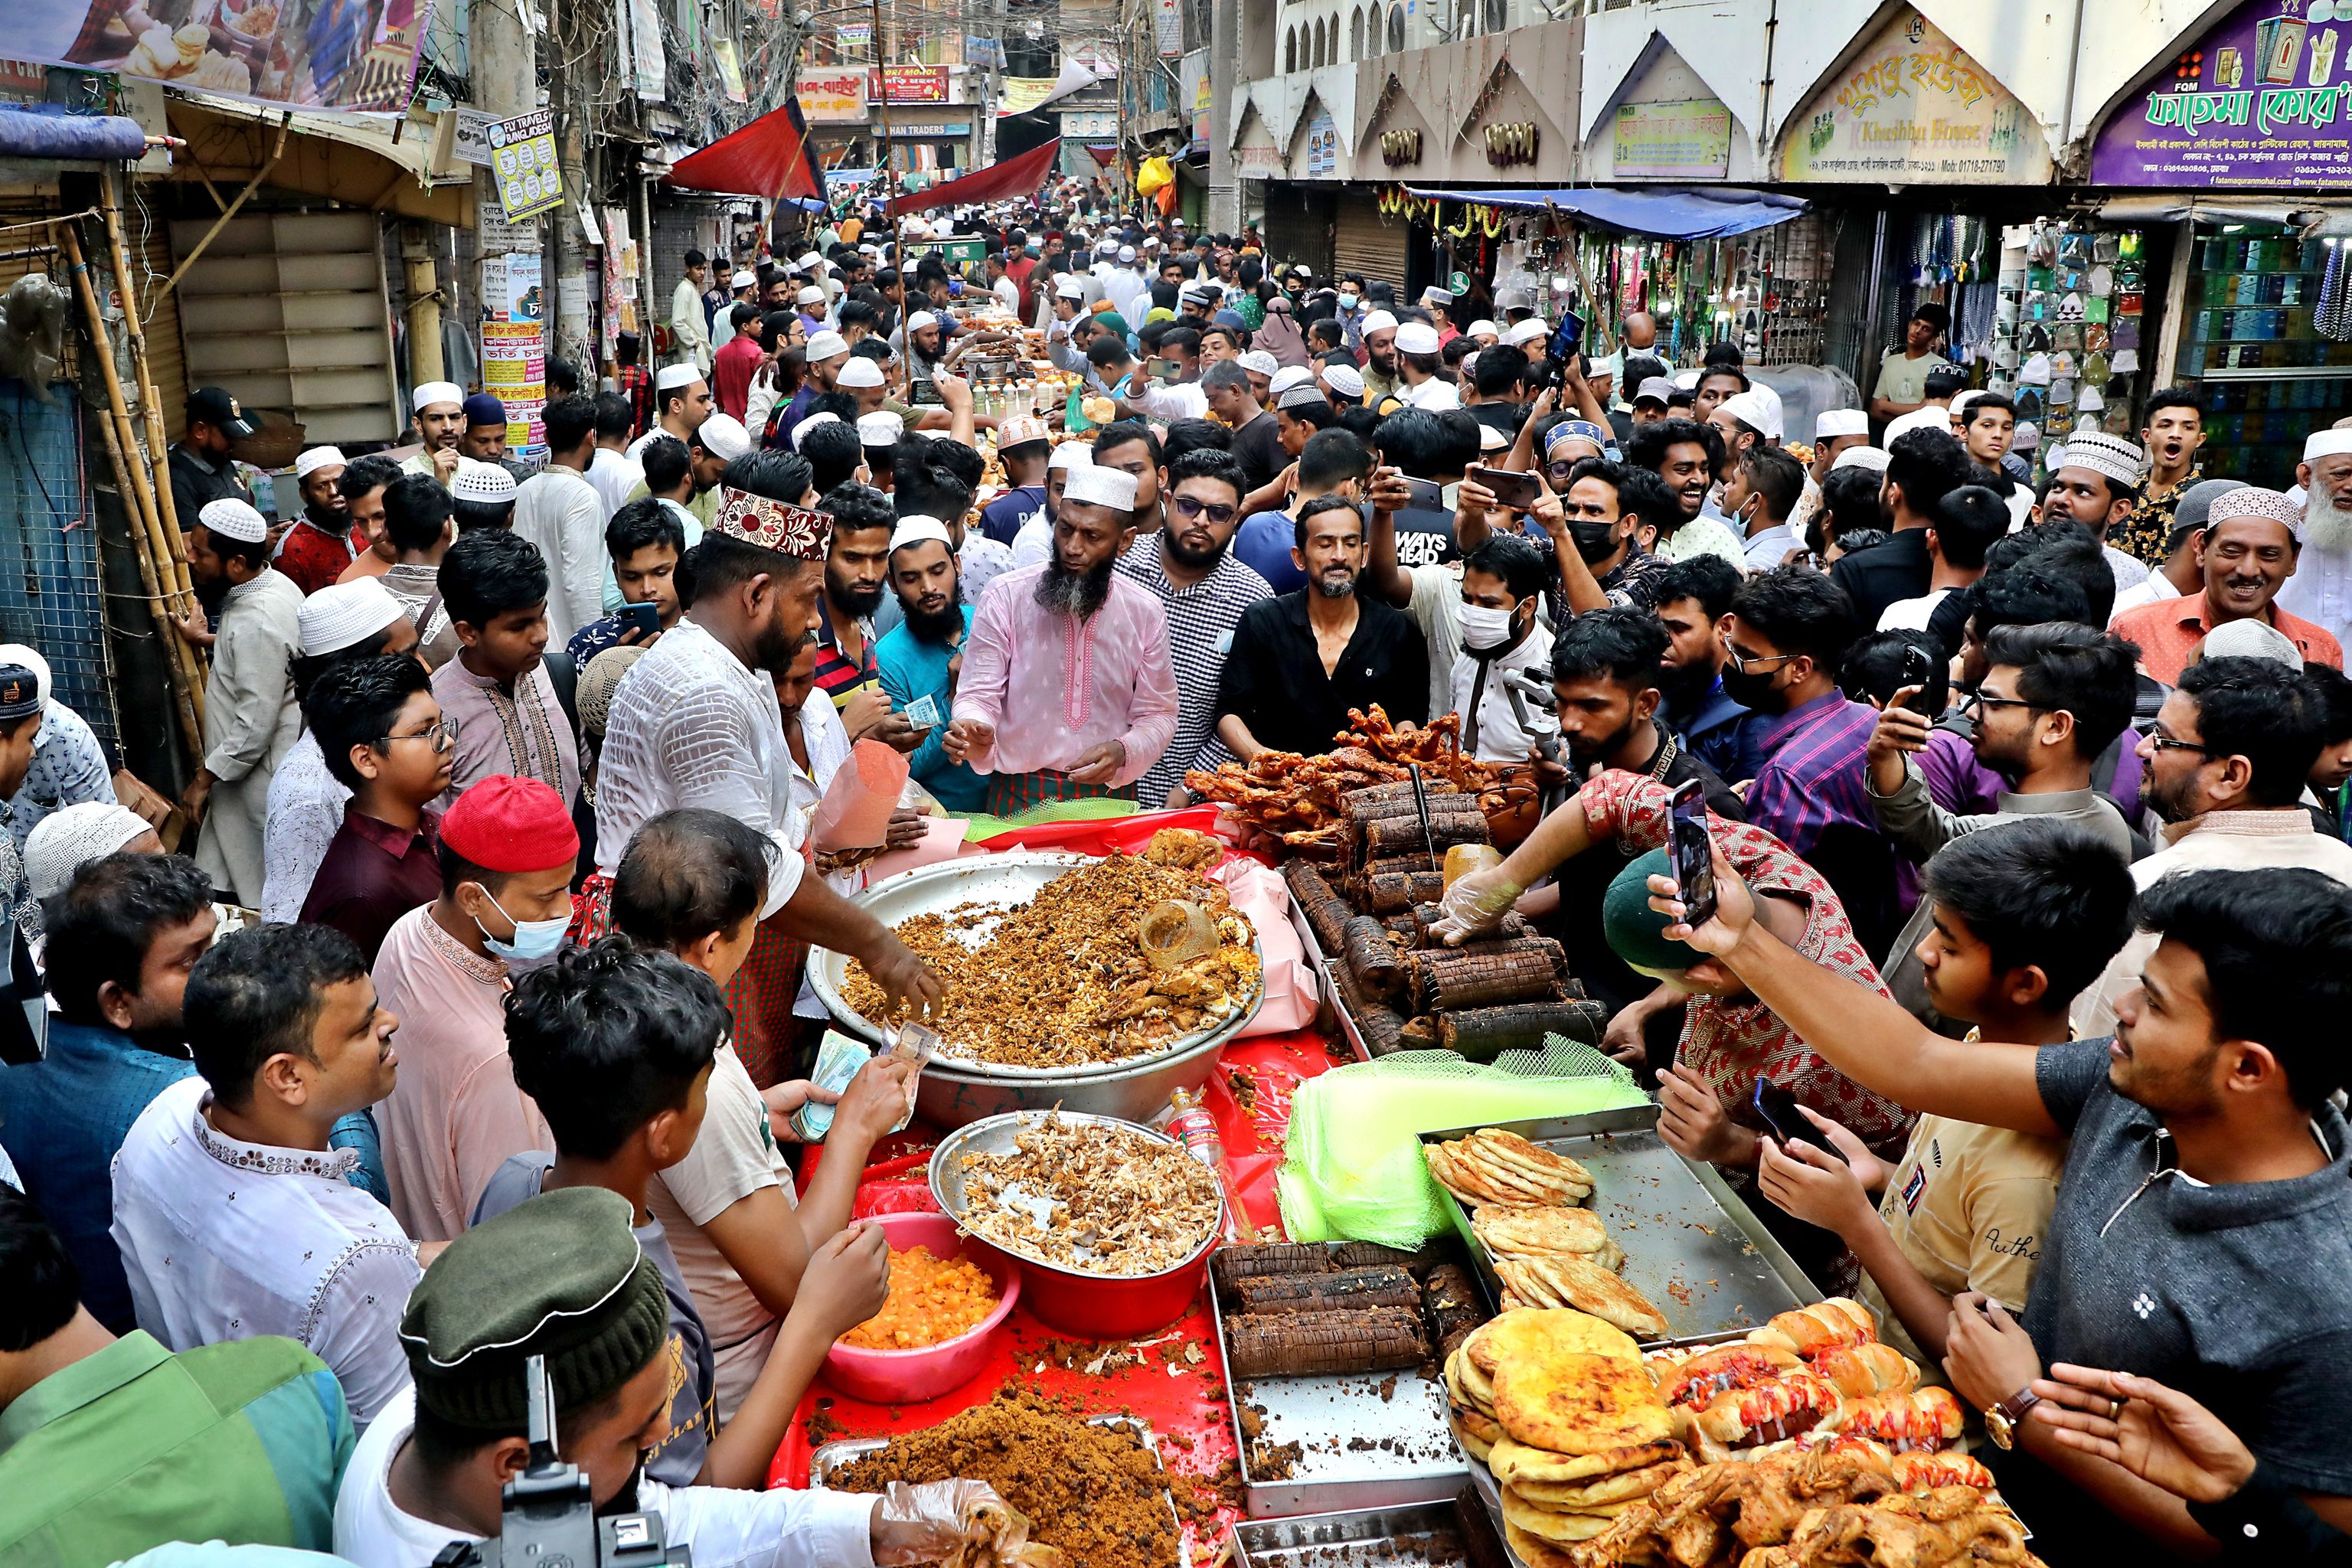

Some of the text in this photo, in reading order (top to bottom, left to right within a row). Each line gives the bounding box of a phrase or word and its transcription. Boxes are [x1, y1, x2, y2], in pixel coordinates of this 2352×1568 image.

[1838, 55, 1909, 117] খুশবু
[2174, 82, 2198, 93] FQM
[2145, 81, 2352, 137] ফাতেমা কোর'
[504, 111, 549, 133] FLY TRAVELS
[908, 126, 945, 135] TRADERS
[1862, 119, 1981, 142] Khushbu House
[506, 122, 551, 143] BANGLADESH
[2136, 139, 2158, 149] ইসলামী
[2159, 139, 2168, 149] বই
[2168, 141, 2192, 150] প্রকাশক,
[2194, 139, 2208, 149] দেশি
[2209, 138, 2230, 149] বিদেশী
[2231, 138, 2249, 149] কাঠের
[2289, 140, 2311, 150] রেহাল,
[2313, 140, 2350, 150] জায়নামাজ,
[2182, 152, 2202, 161] দোকান
[2238, 152, 2249, 161] চক
[2249, 152, 2275, 162] সার্কুলার
[2277, 152, 2294, 161] রোড
[2295, 152, 2308, 162] (চক
[2309, 152, 2331, 162] বাজার
[1942, 160, 1958, 172] Mob:
[1958, 159, 2005, 173] 01718-271790
[2215, 177, 2292, 186] fatamaquranmohal.com
[486, 347, 519, 358] ভর্তি
[1395, 531, 1447, 551] WAYS
[1984, 1228, 2041, 1261] Authe
